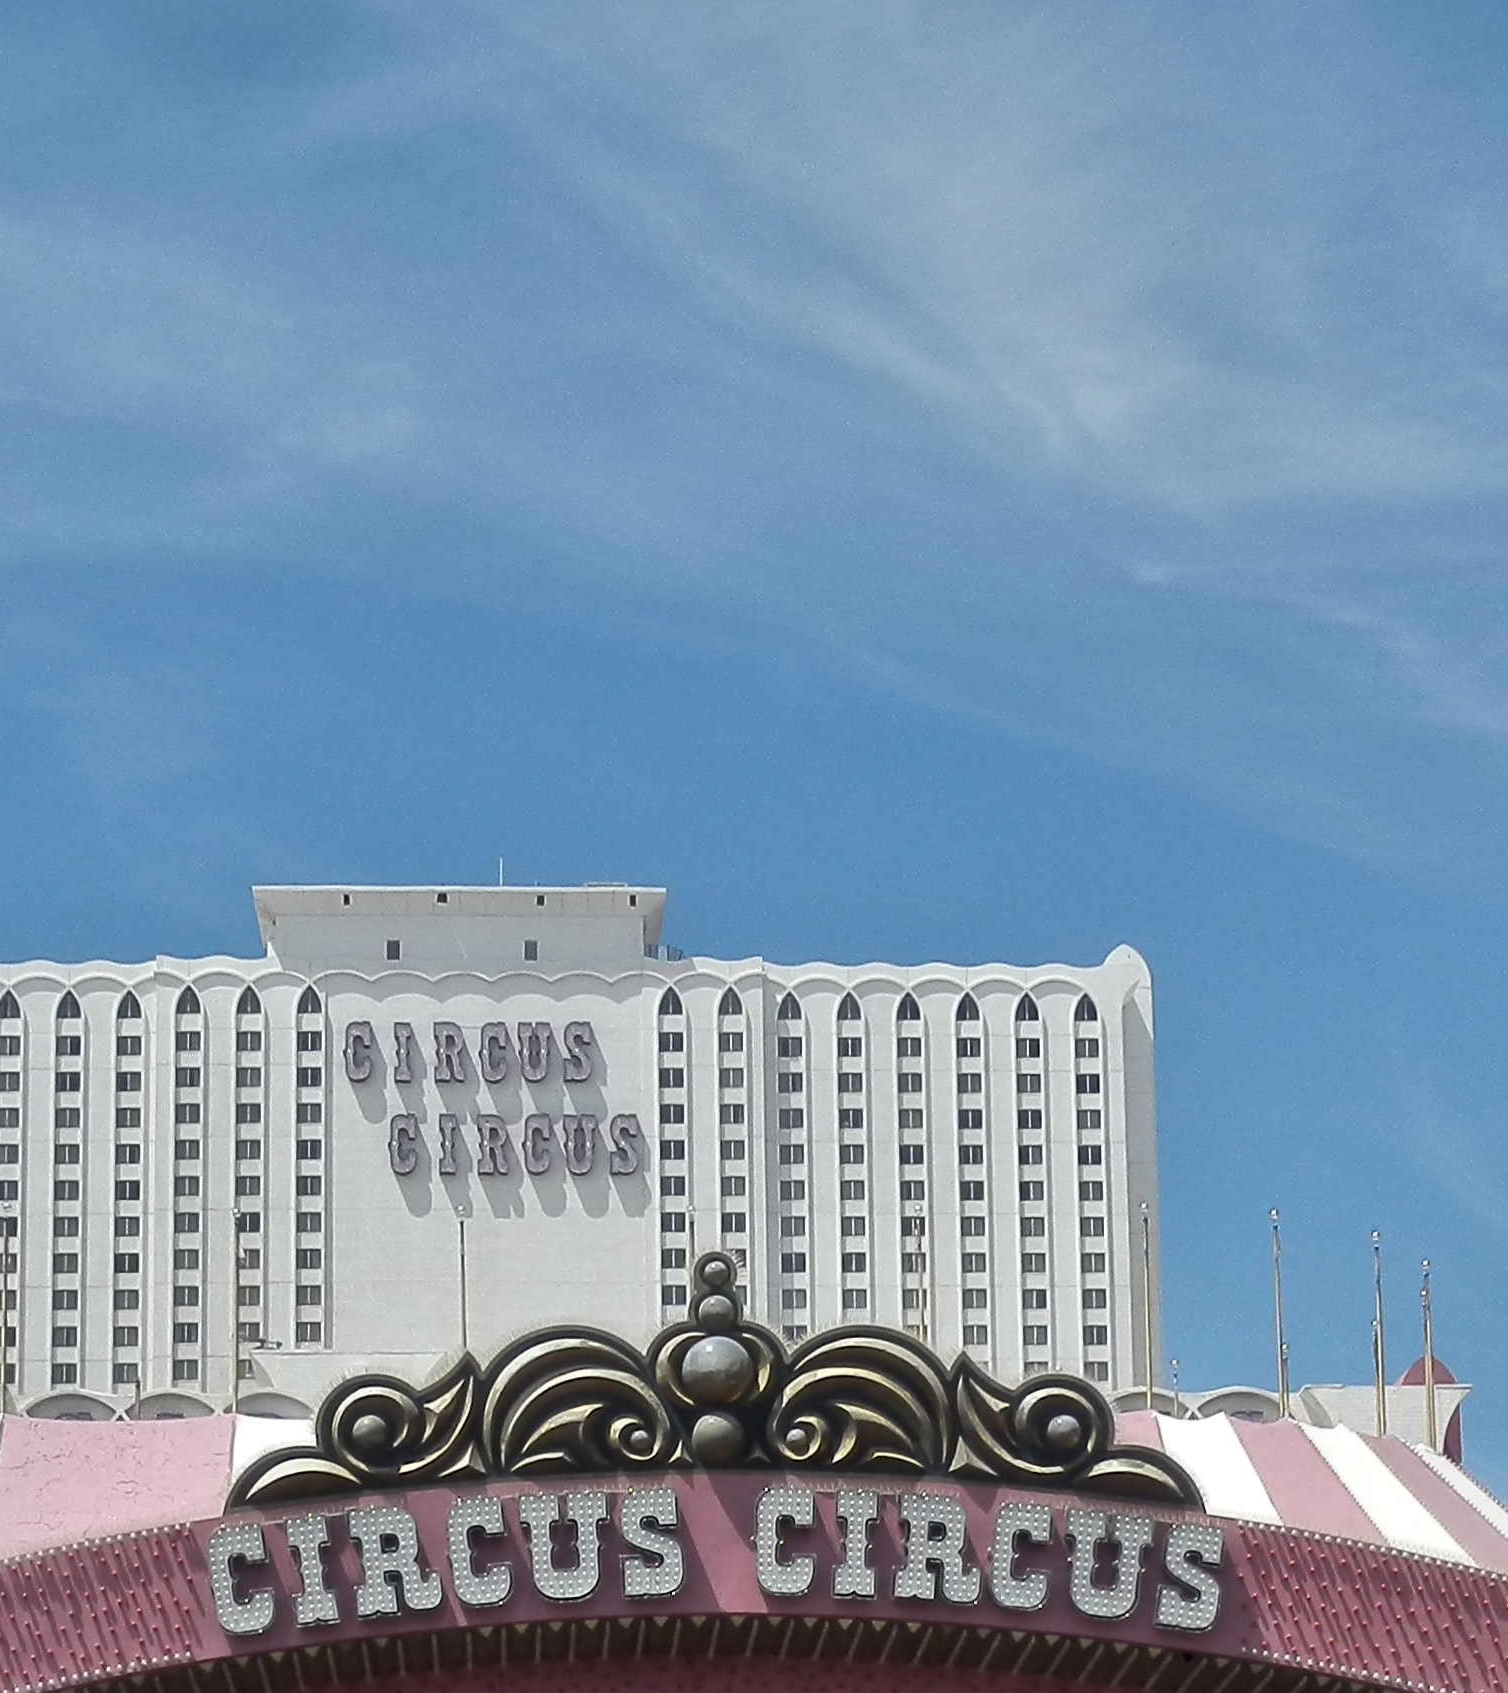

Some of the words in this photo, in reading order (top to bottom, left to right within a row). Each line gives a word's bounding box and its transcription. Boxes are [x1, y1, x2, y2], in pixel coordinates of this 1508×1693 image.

[343, 1021, 593, 1083] CIRCUS
[388, 1113, 640, 1175] CIRCUS
[208, 1487, 686, 1637] CIRCUS
[754, 1483, 1225, 1635] CIRCUS
